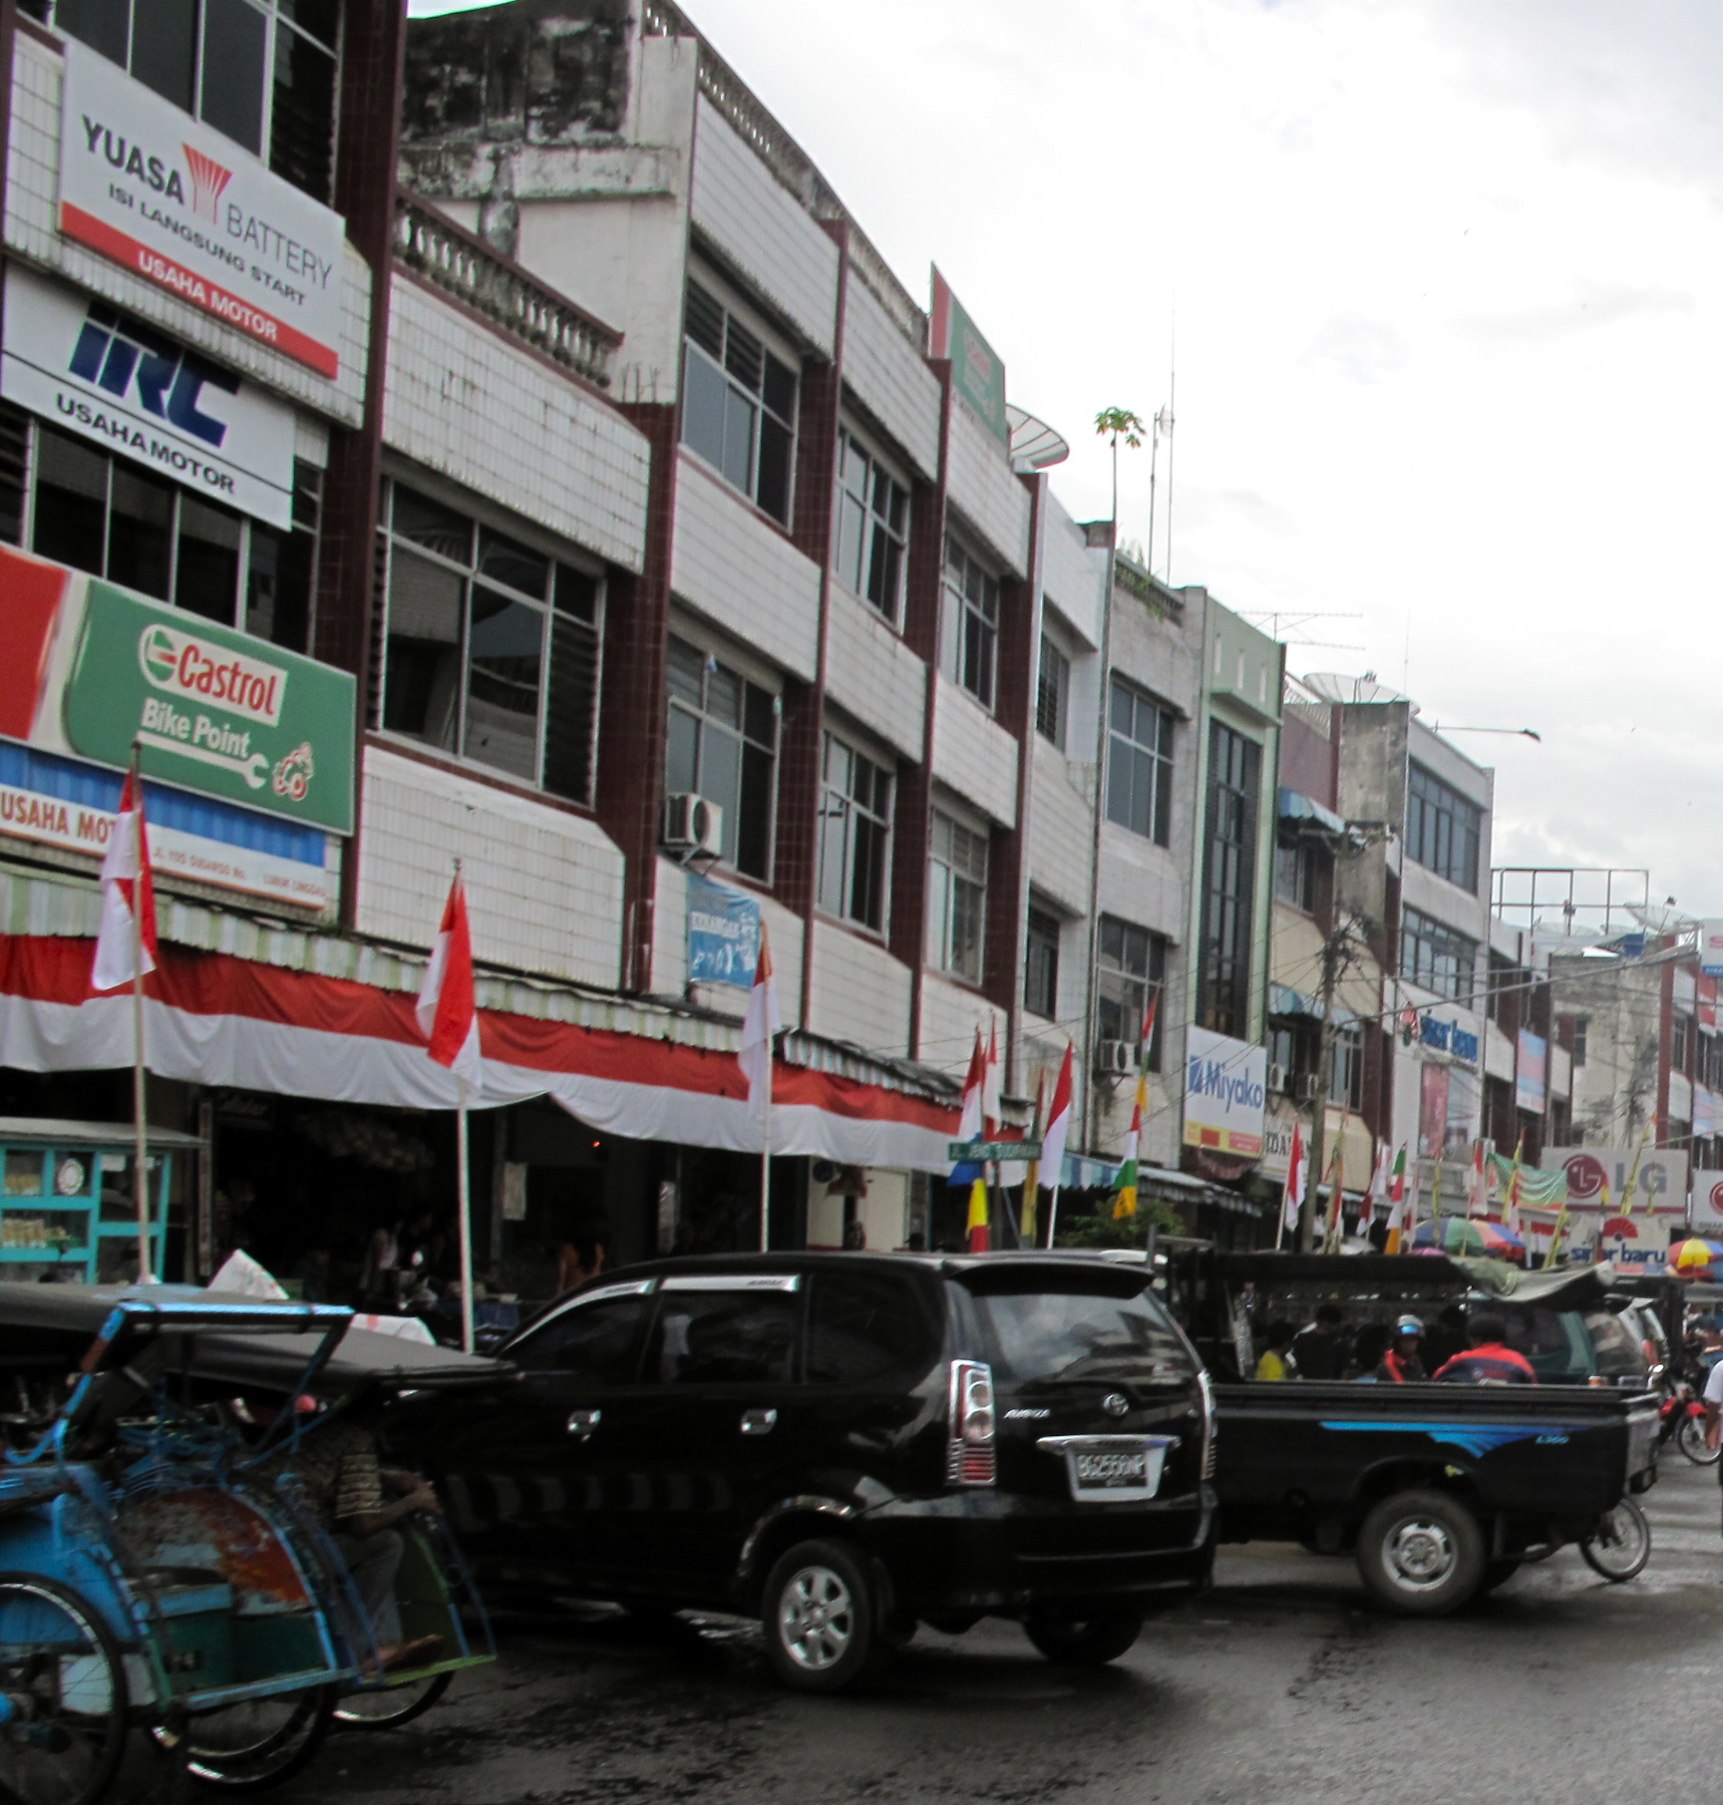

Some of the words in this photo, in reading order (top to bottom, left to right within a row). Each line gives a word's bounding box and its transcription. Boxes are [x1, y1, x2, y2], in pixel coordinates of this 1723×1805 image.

[80, 113, 185, 206] YUASA
[108, 182, 134, 209] ISI
[140, 198, 246, 274] LANGSUNG
[249, 265, 306, 307] START
[226, 202, 334, 292] BATTERY
[138, 249, 206, 304] USAHA
[210, 289, 279, 343] MOTOR
[57, 391, 147, 455] USAHA
[149, 439, 237, 496] MOTOR
[178, 642, 278, 717] Castrol
[141, 696, 191, 741] Bike
[193, 713, 251, 759] Point
[0, 790, 70, 836] USAHA
[77, 818, 117, 846] MOT
[1205, 1059, 1263, 1114] Miyako
[1614, 1161, 1668, 1194] LG
[1621, 1242, 1667, 1263] baru
